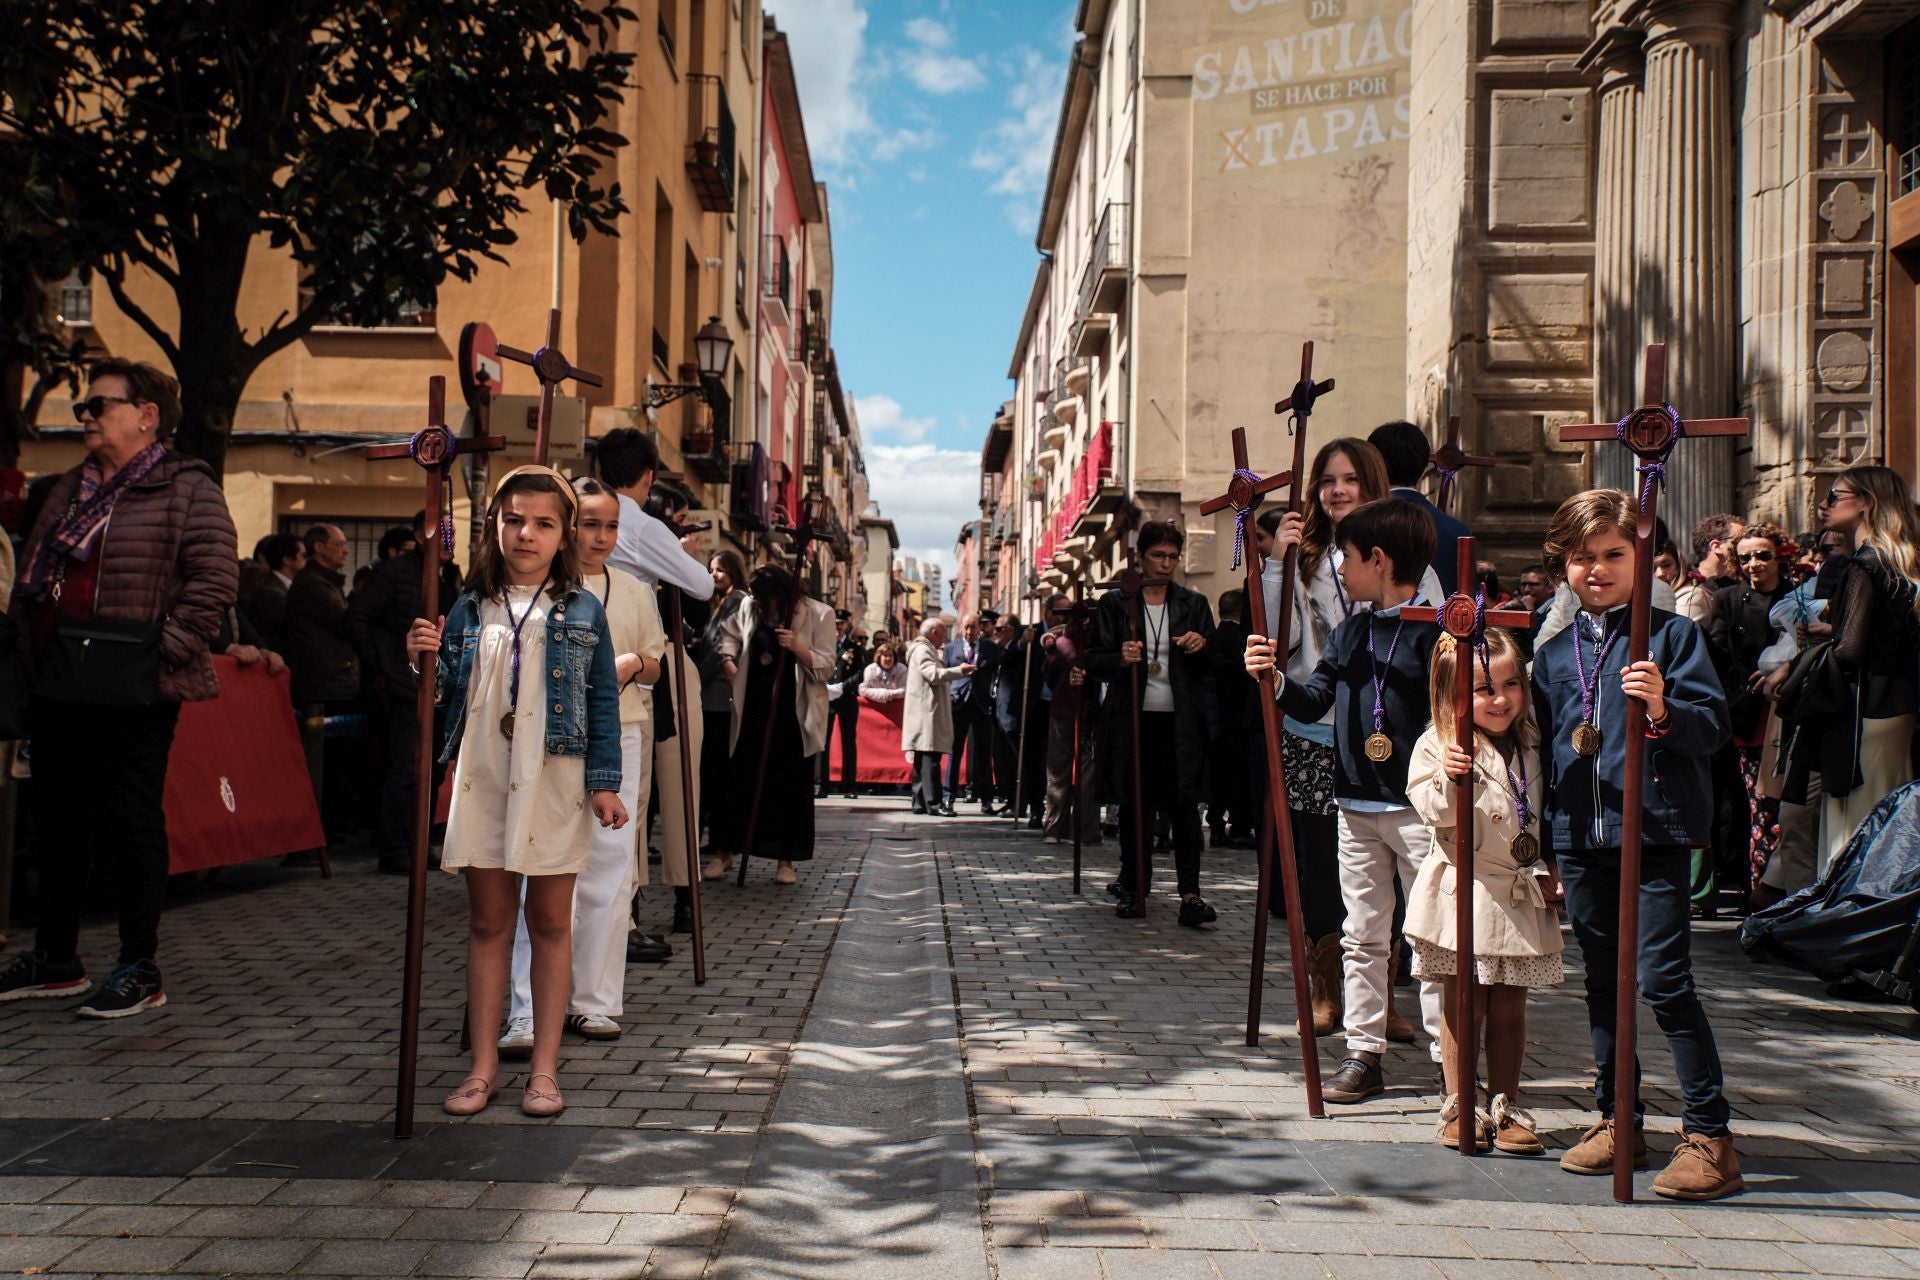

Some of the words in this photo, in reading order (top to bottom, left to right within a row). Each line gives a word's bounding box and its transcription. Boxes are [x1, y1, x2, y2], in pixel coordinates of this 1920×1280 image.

[1311, 0, 1342, 21] DE
[1255, 89, 1280, 109] SE
[1285, 82, 1342, 105] HACE
[1347, 76, 1388, 98] POR
